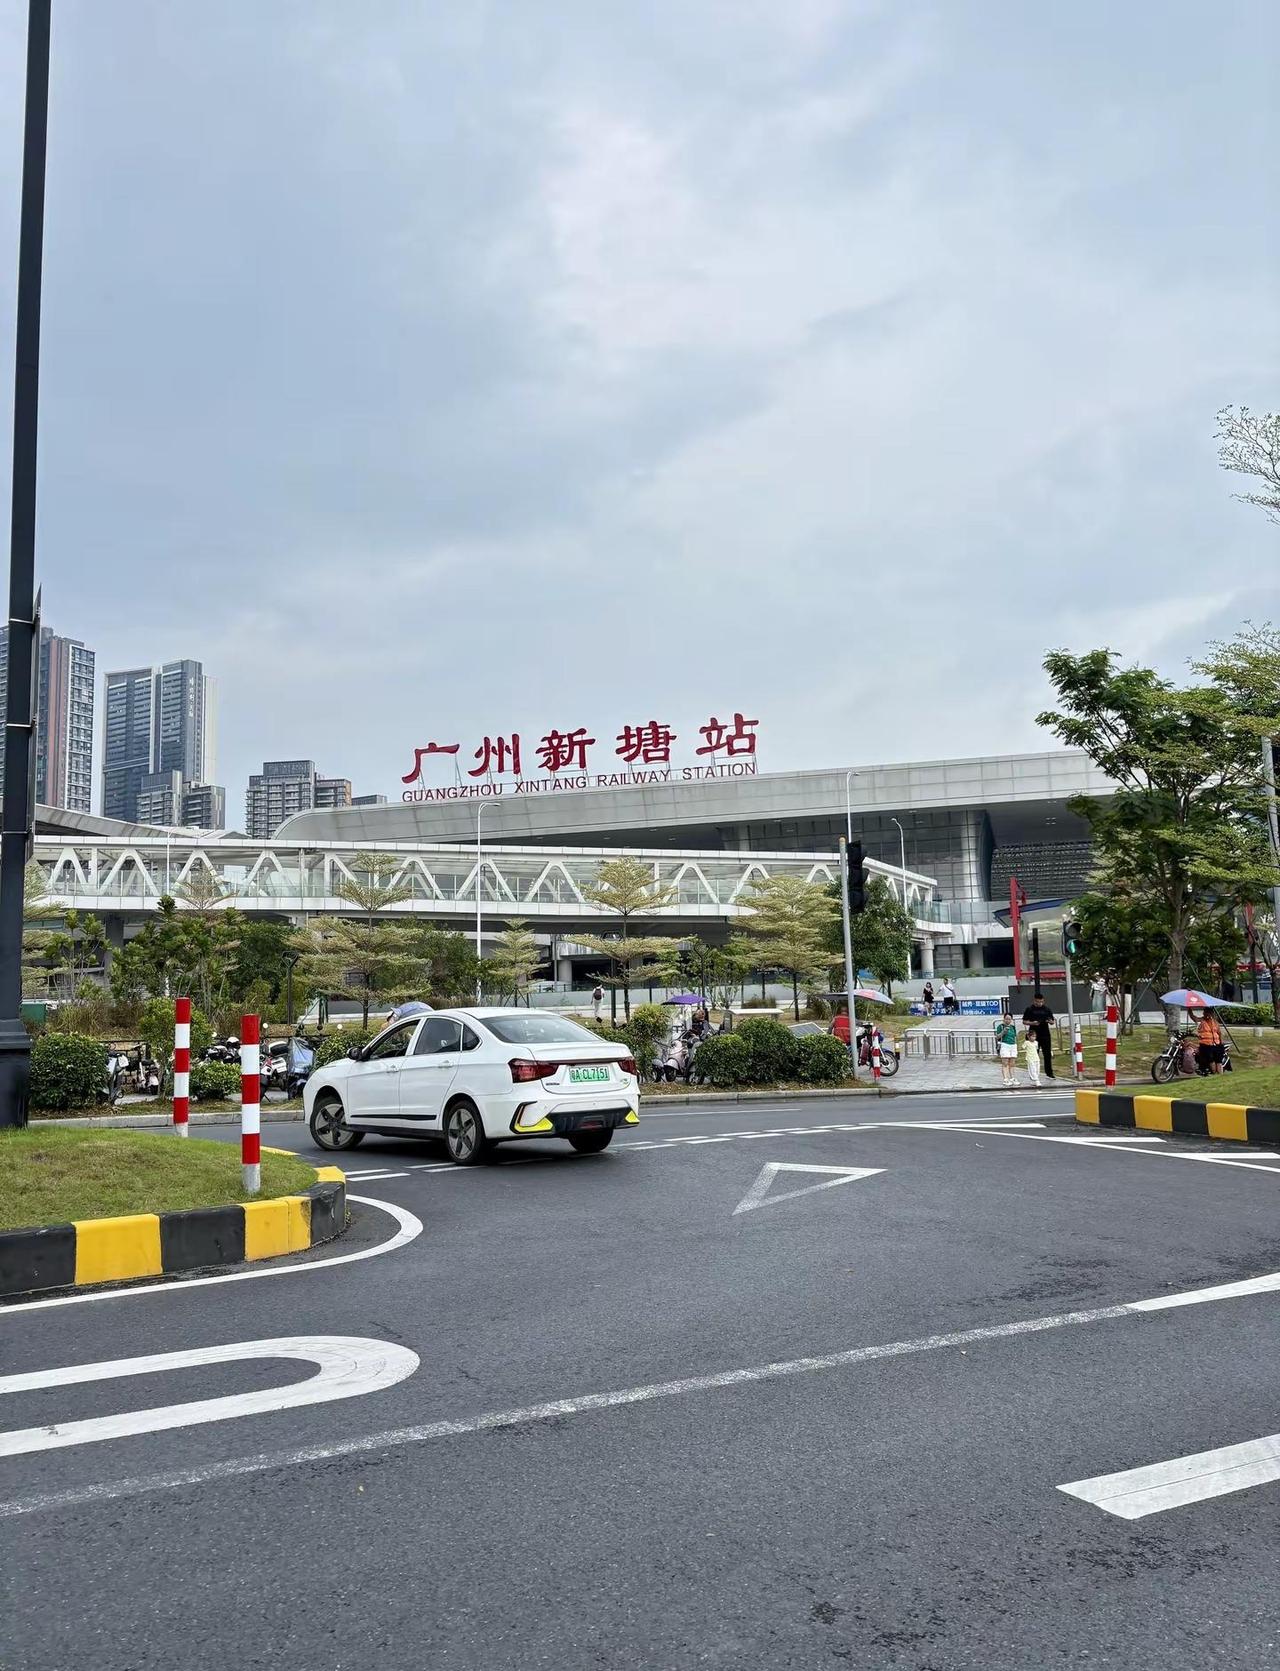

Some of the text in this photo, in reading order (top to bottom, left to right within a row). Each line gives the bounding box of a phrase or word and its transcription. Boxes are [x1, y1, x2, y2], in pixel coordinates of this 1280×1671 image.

[401, 713, 759, 784] 广州新塘站
[402, 762, 756, 803] GUANGZHOU XINTANG RAILWAY STATION
